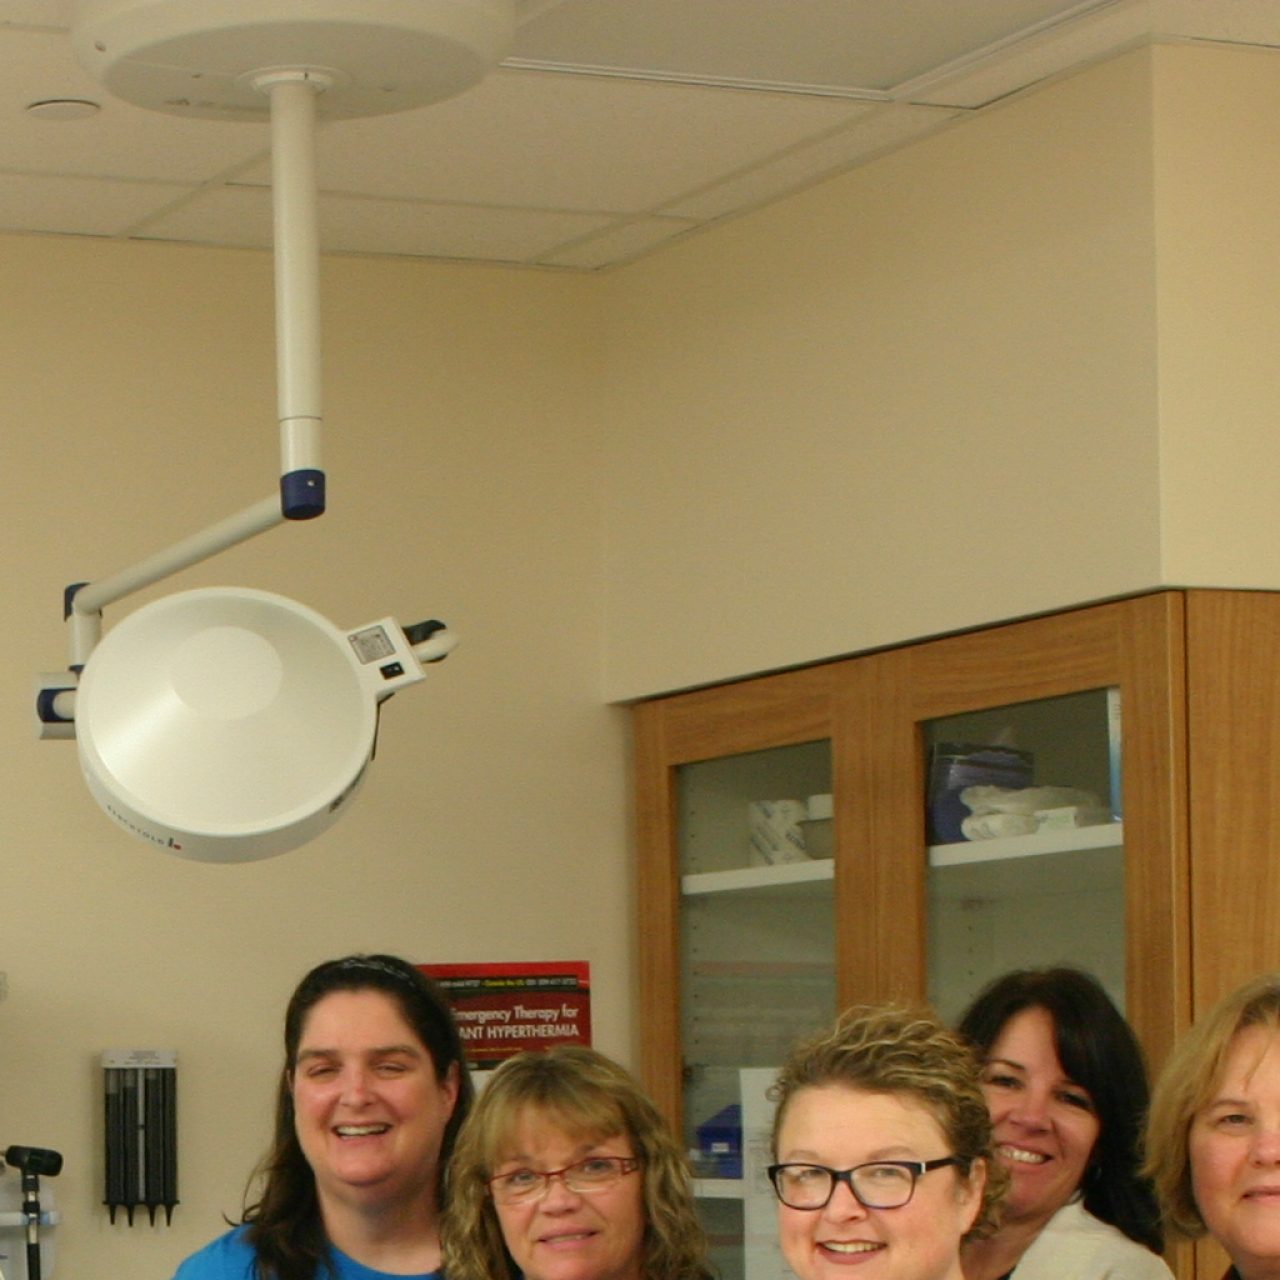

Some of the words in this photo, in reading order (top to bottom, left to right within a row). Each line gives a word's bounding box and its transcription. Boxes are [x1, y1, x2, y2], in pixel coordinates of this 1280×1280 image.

[514, 1004, 559, 1022] Therapy
[562, 1003, 579, 1018] for
[458, 1026, 484, 1040] ANT
[487, 1024, 580, 1039] HYPERTHERMIA
